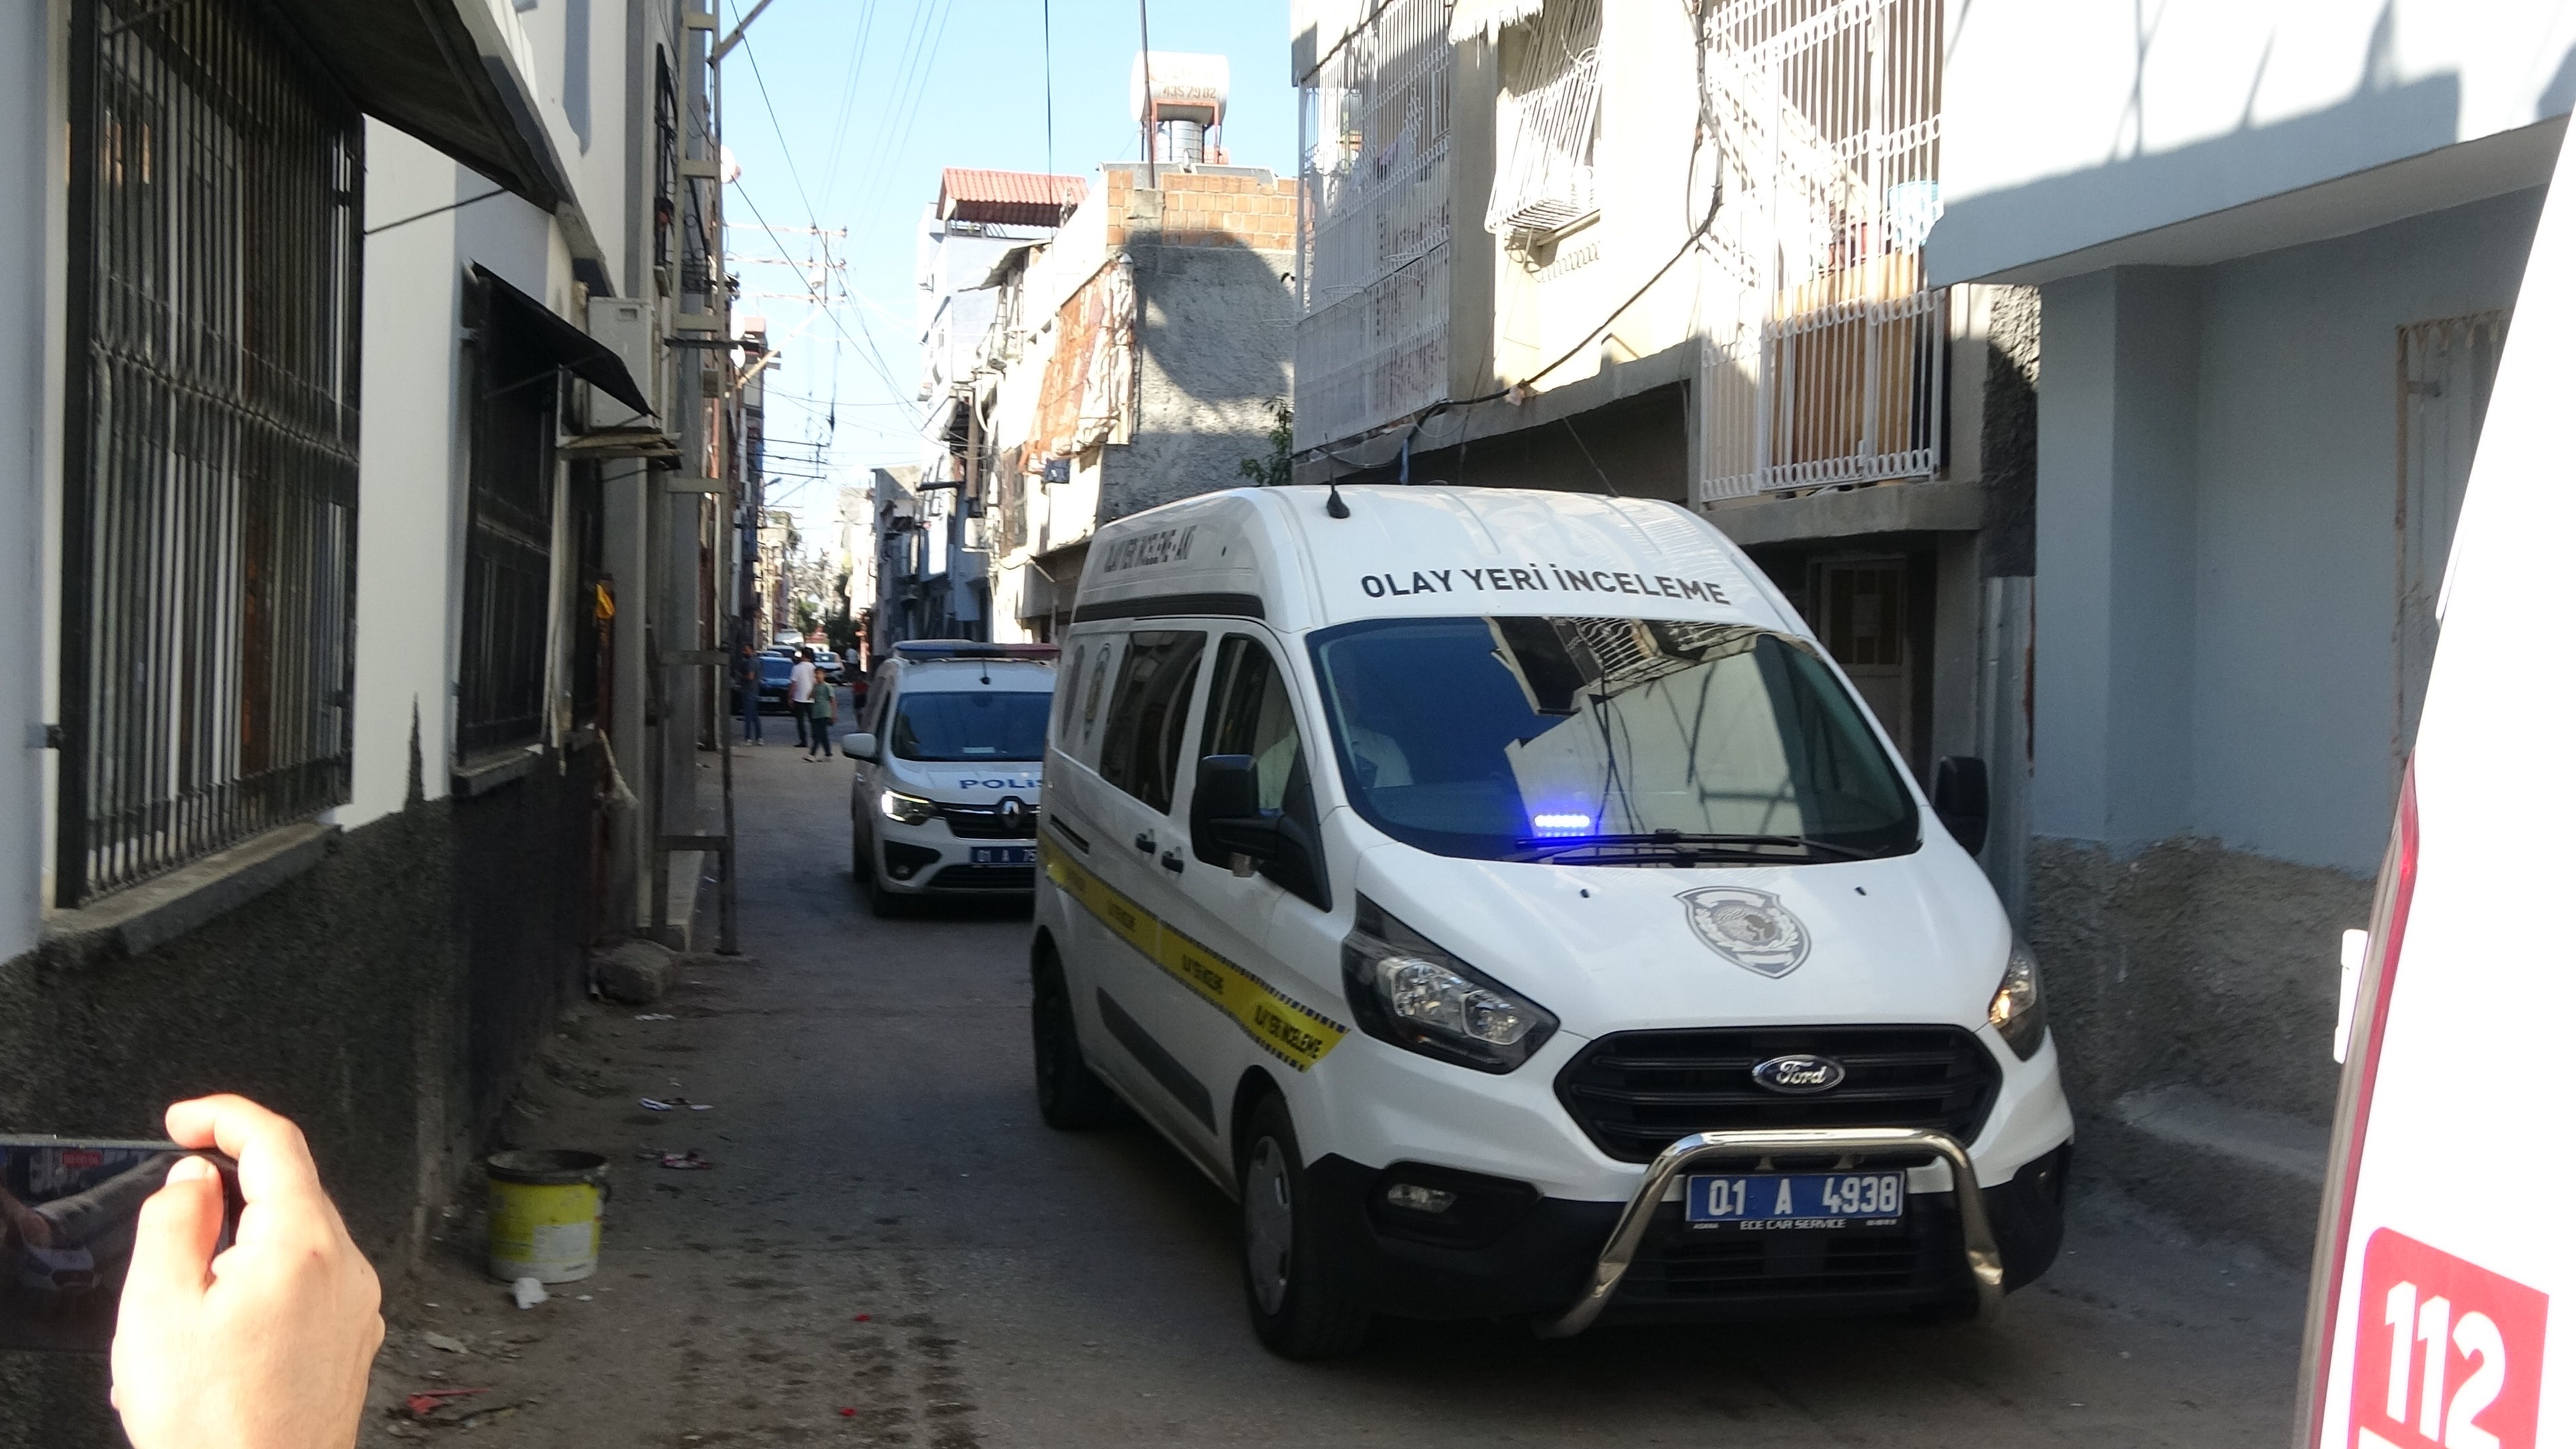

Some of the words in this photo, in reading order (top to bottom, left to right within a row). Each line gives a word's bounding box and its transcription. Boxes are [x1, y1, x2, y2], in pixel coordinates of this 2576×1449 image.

[1360, 570, 1453, 598] OLAY
[1460, 563, 1550, 590] YERİ
[1548, 564, 1732, 605] İNCELEME
[1001, 849, 1011, 862] A
[1774, 1060, 1827, 1085] Ford
[1709, 1179, 1746, 1216] 01
[1774, 1178, 1793, 1215] A
[1822, 1176, 1898, 1214] 4938
[1739, 1220, 1765, 1230] ECE
[1766, 1220, 1795, 1230] CAR
[1794, 1219, 1847, 1229] SERVICE
[2385, 1280, 2506, 1449] 112
